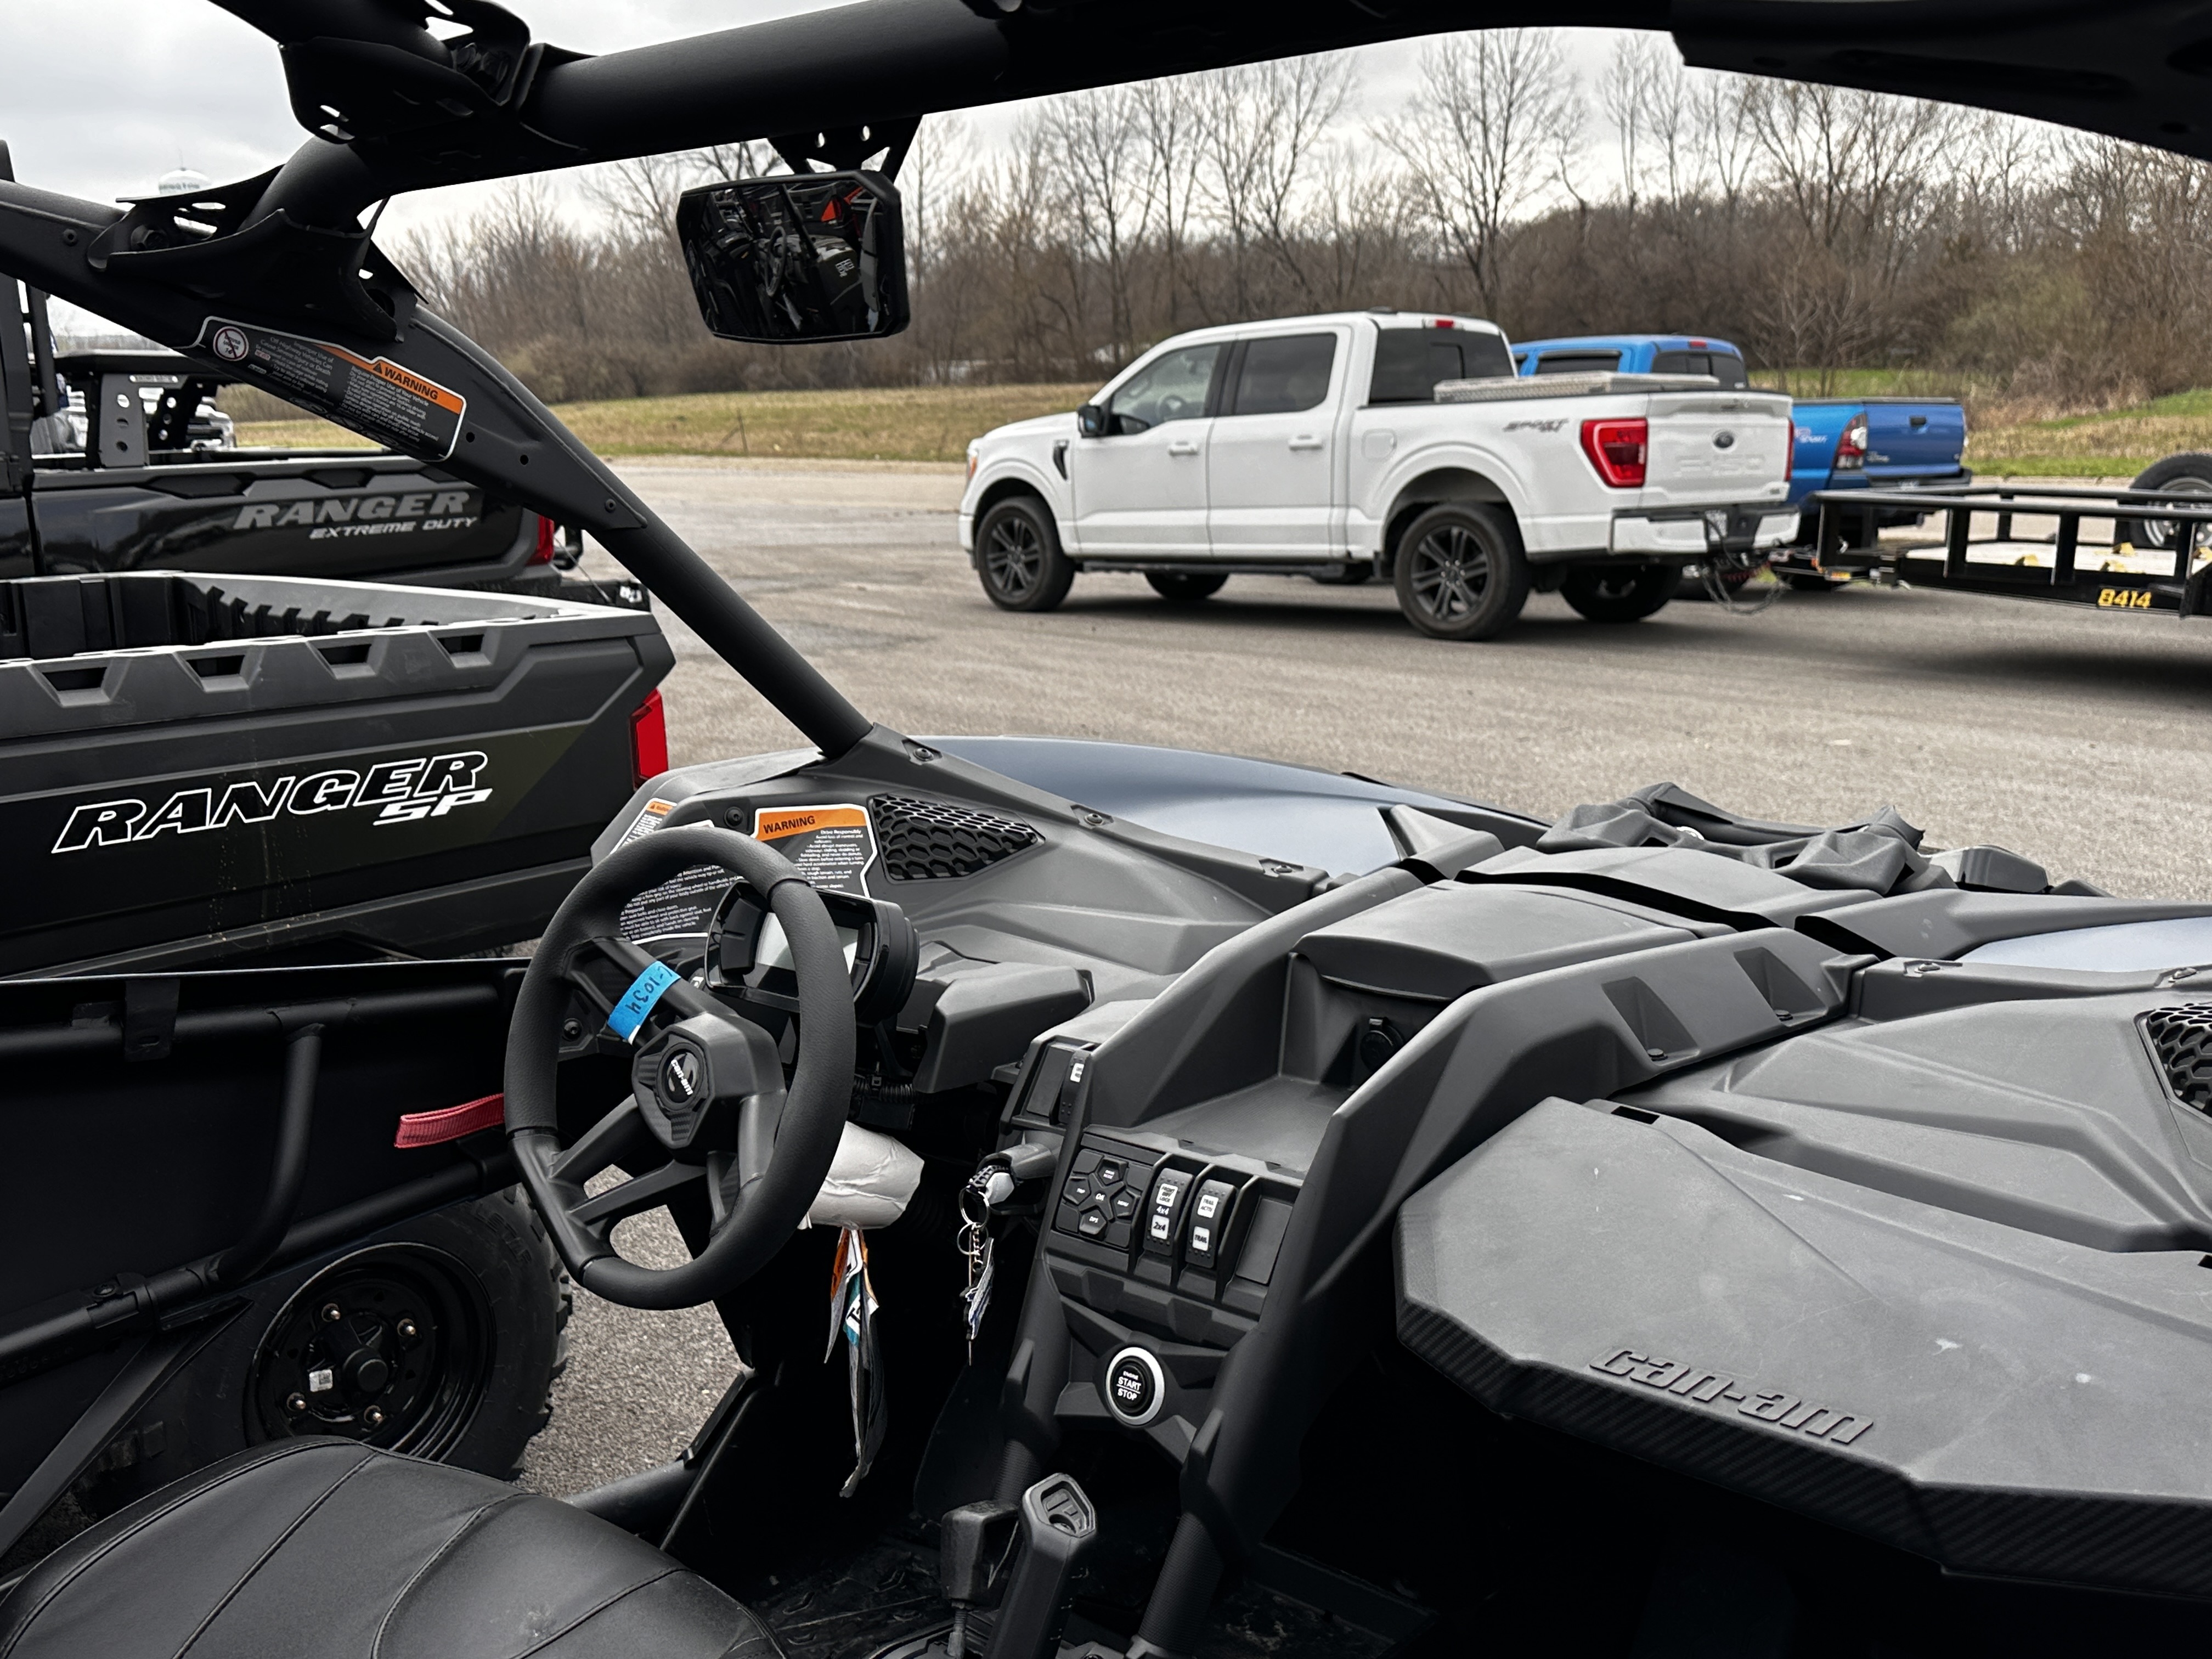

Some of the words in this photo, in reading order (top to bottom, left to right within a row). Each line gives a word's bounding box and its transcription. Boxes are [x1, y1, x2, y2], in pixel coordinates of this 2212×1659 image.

[385, 368, 438, 400] WARNING
[233, 492, 470, 530] RANGER
[309, 521, 416, 539] EXTREME
[422, 517, 478, 531] DUTY
[2097, 589, 2152, 609] 8414
[52, 751, 488, 854] RANGER
[373, 788, 493, 826] SP
[763, 815, 816, 834] WARNING
[670, 1059, 693, 1096] can-am
[1156, 1205, 1170, 1215] 4x4
[1153, 1221, 1166, 1232] 2x4
[1117, 1387, 1138, 1401] STOP
[1118, 1376, 1142, 1391] START
[1589, 1346, 1874, 1446] can-am
